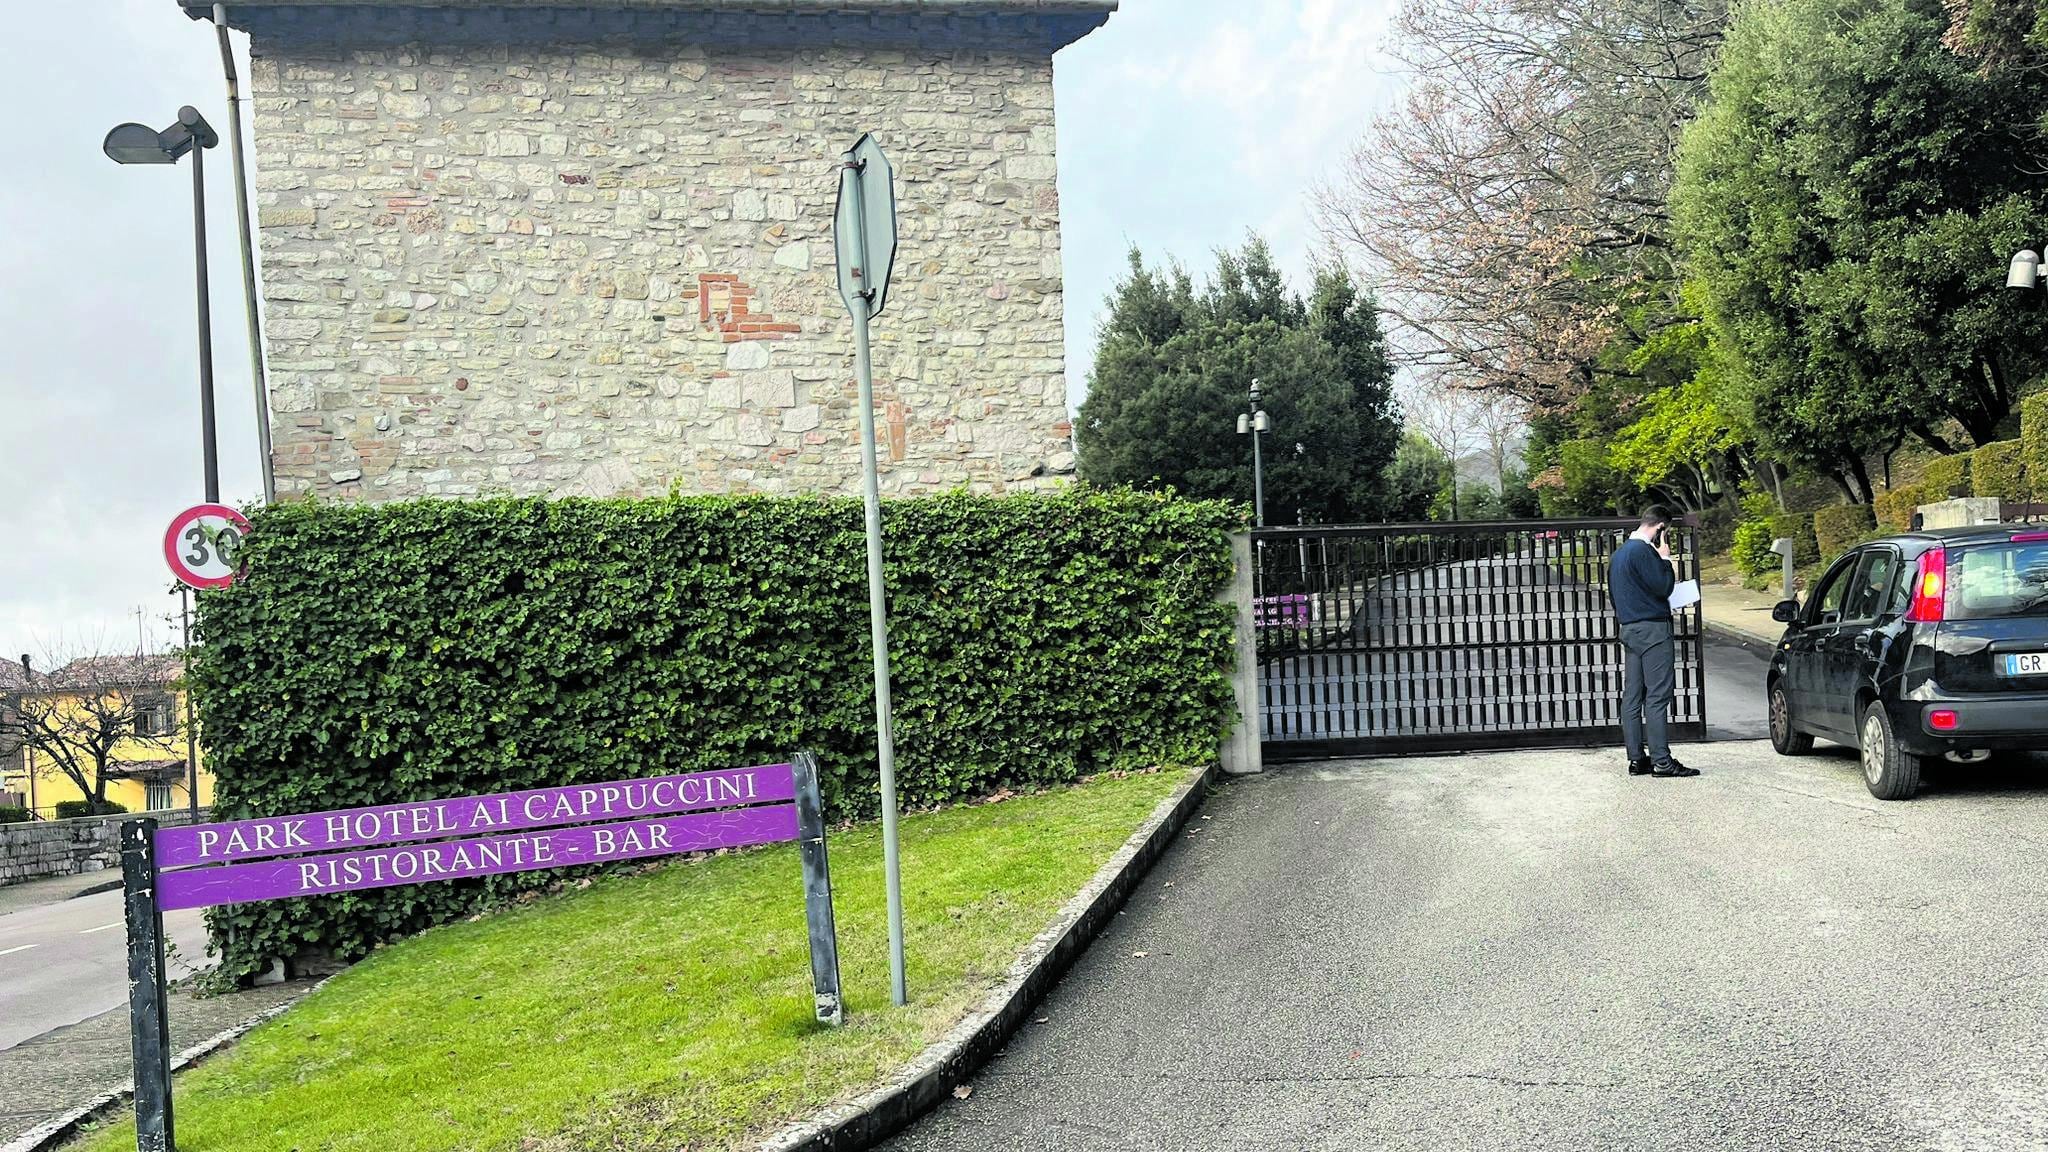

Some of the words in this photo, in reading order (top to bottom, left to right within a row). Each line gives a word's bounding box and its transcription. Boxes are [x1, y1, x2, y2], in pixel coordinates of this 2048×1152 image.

[2020, 655, 2041, 671] GR
[198, 819, 311, 858] PARK
[324, 804, 458, 843] HOTEL
[469, 798, 510, 828] AI
[523, 772, 757, 821] CAPPUCCINI
[298, 834, 554, 891] RISTORANTE
[592, 823, 673, 857] BAR
